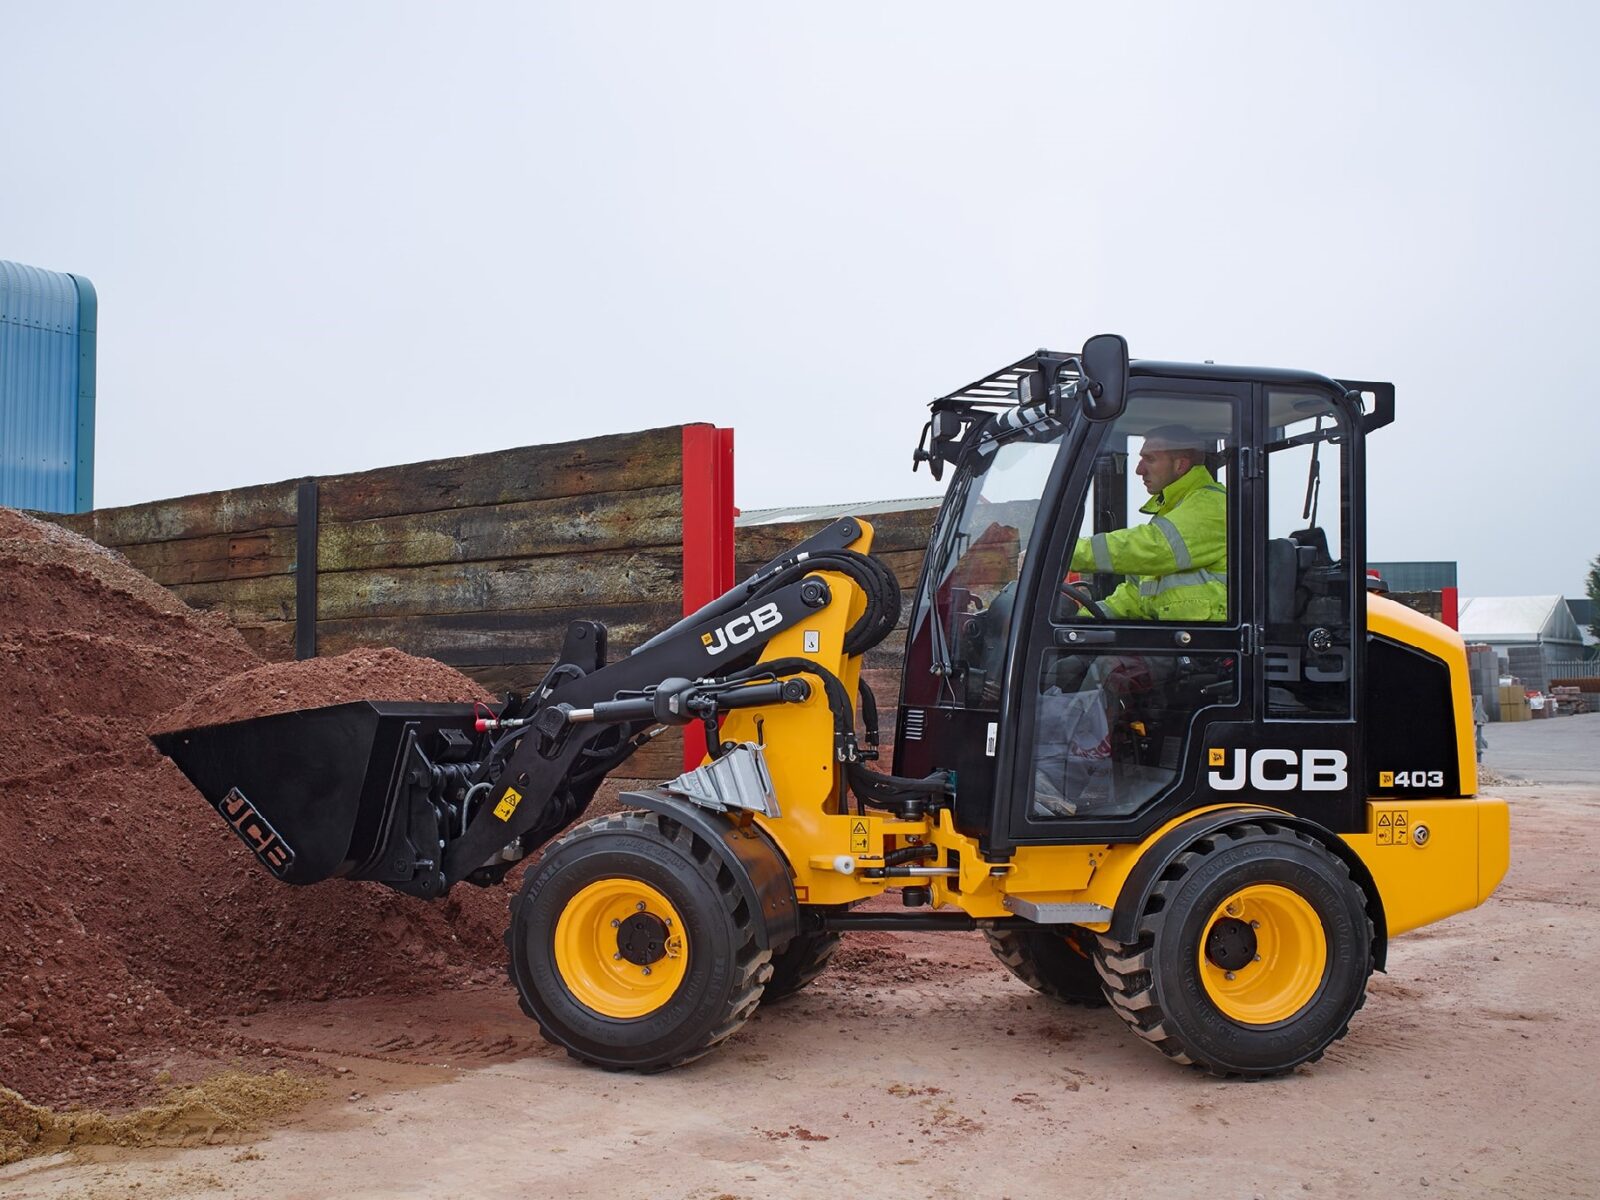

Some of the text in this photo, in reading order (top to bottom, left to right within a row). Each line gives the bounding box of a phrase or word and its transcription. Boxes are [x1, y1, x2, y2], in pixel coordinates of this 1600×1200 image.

[705, 602, 783, 656] JCB
[1208, 748, 1348, 791] JCB
[1394, 770, 1444, 788] 403
[219, 787, 295, 877] JCB
[1201, 851, 1239, 882] POWER
